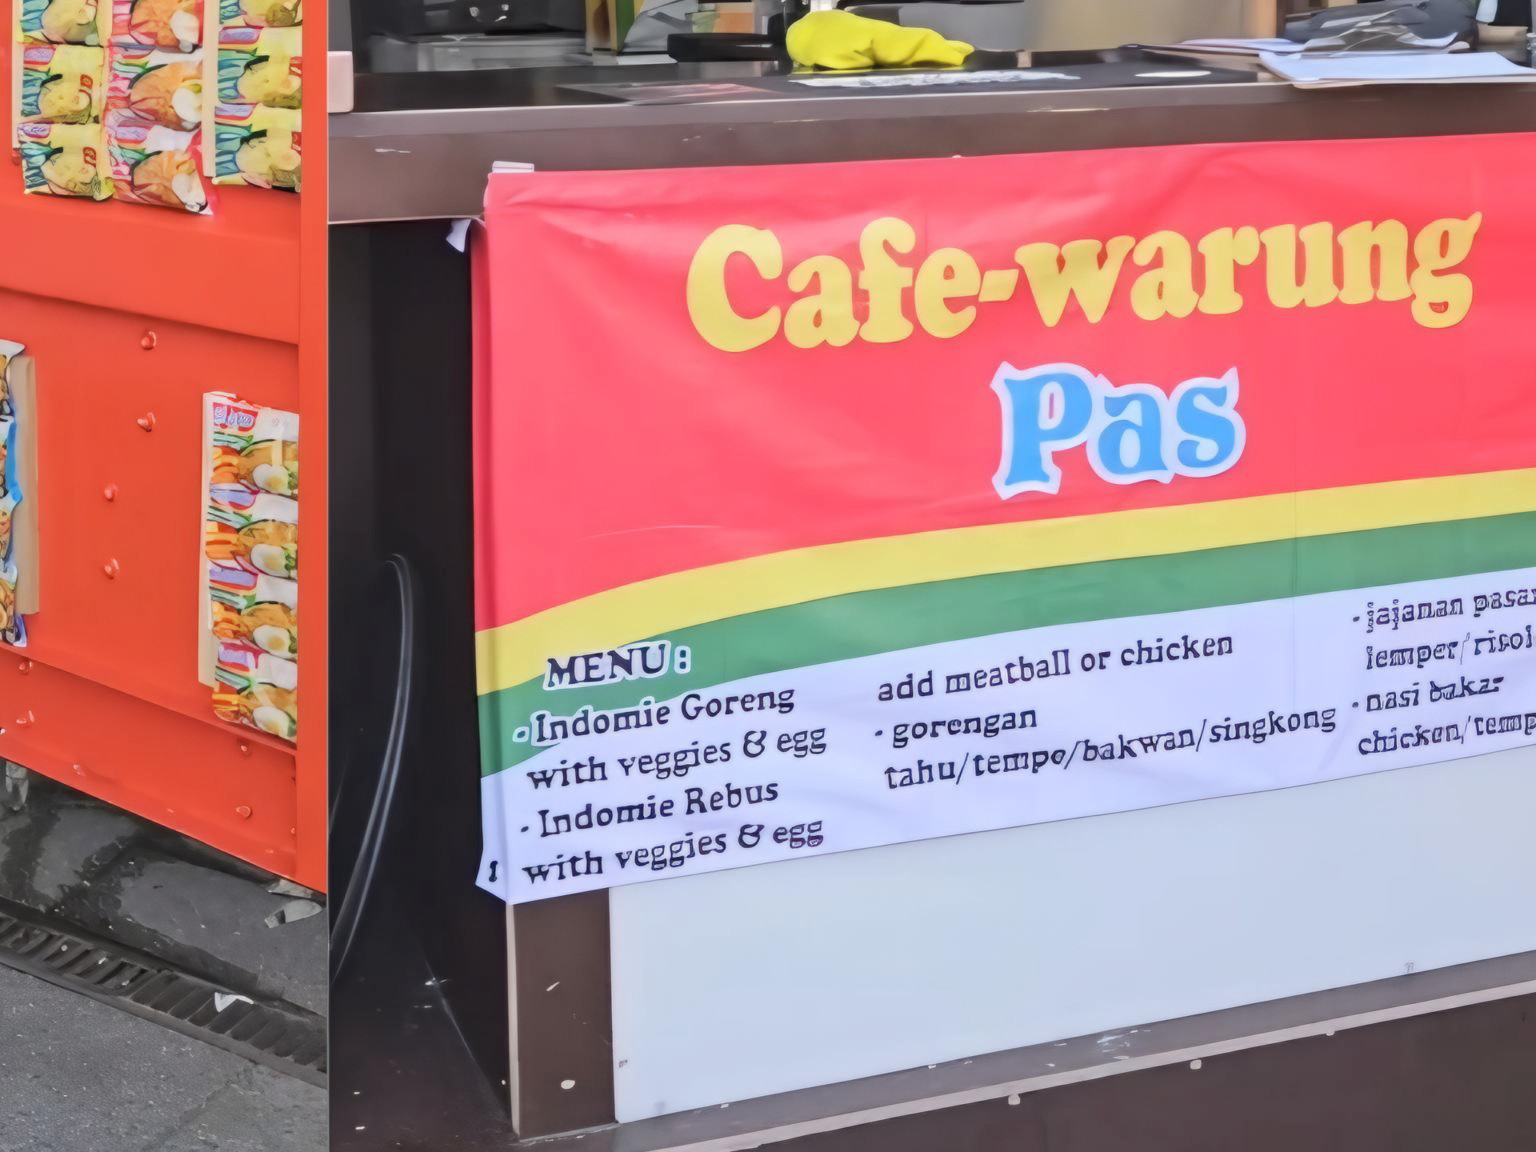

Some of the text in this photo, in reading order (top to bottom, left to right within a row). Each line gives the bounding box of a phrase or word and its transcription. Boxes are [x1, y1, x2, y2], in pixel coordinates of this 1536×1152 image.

[686, 214, 1482, 352] Cafe-warung
[991, 362, 1246, 500] Pas
[877, 635, 1234, 702] add meatball or chicken
[1366, 681, 1420, 712] nasi
[536, 689, 795, 743] Indomie Goreng
[892, 709, 1038, 749] gorengan
[527, 728, 827, 790] with veggies & egg
[537, 782, 779, 837] Indomie Rebus
[522, 820, 823, 884] with veggies & egg
